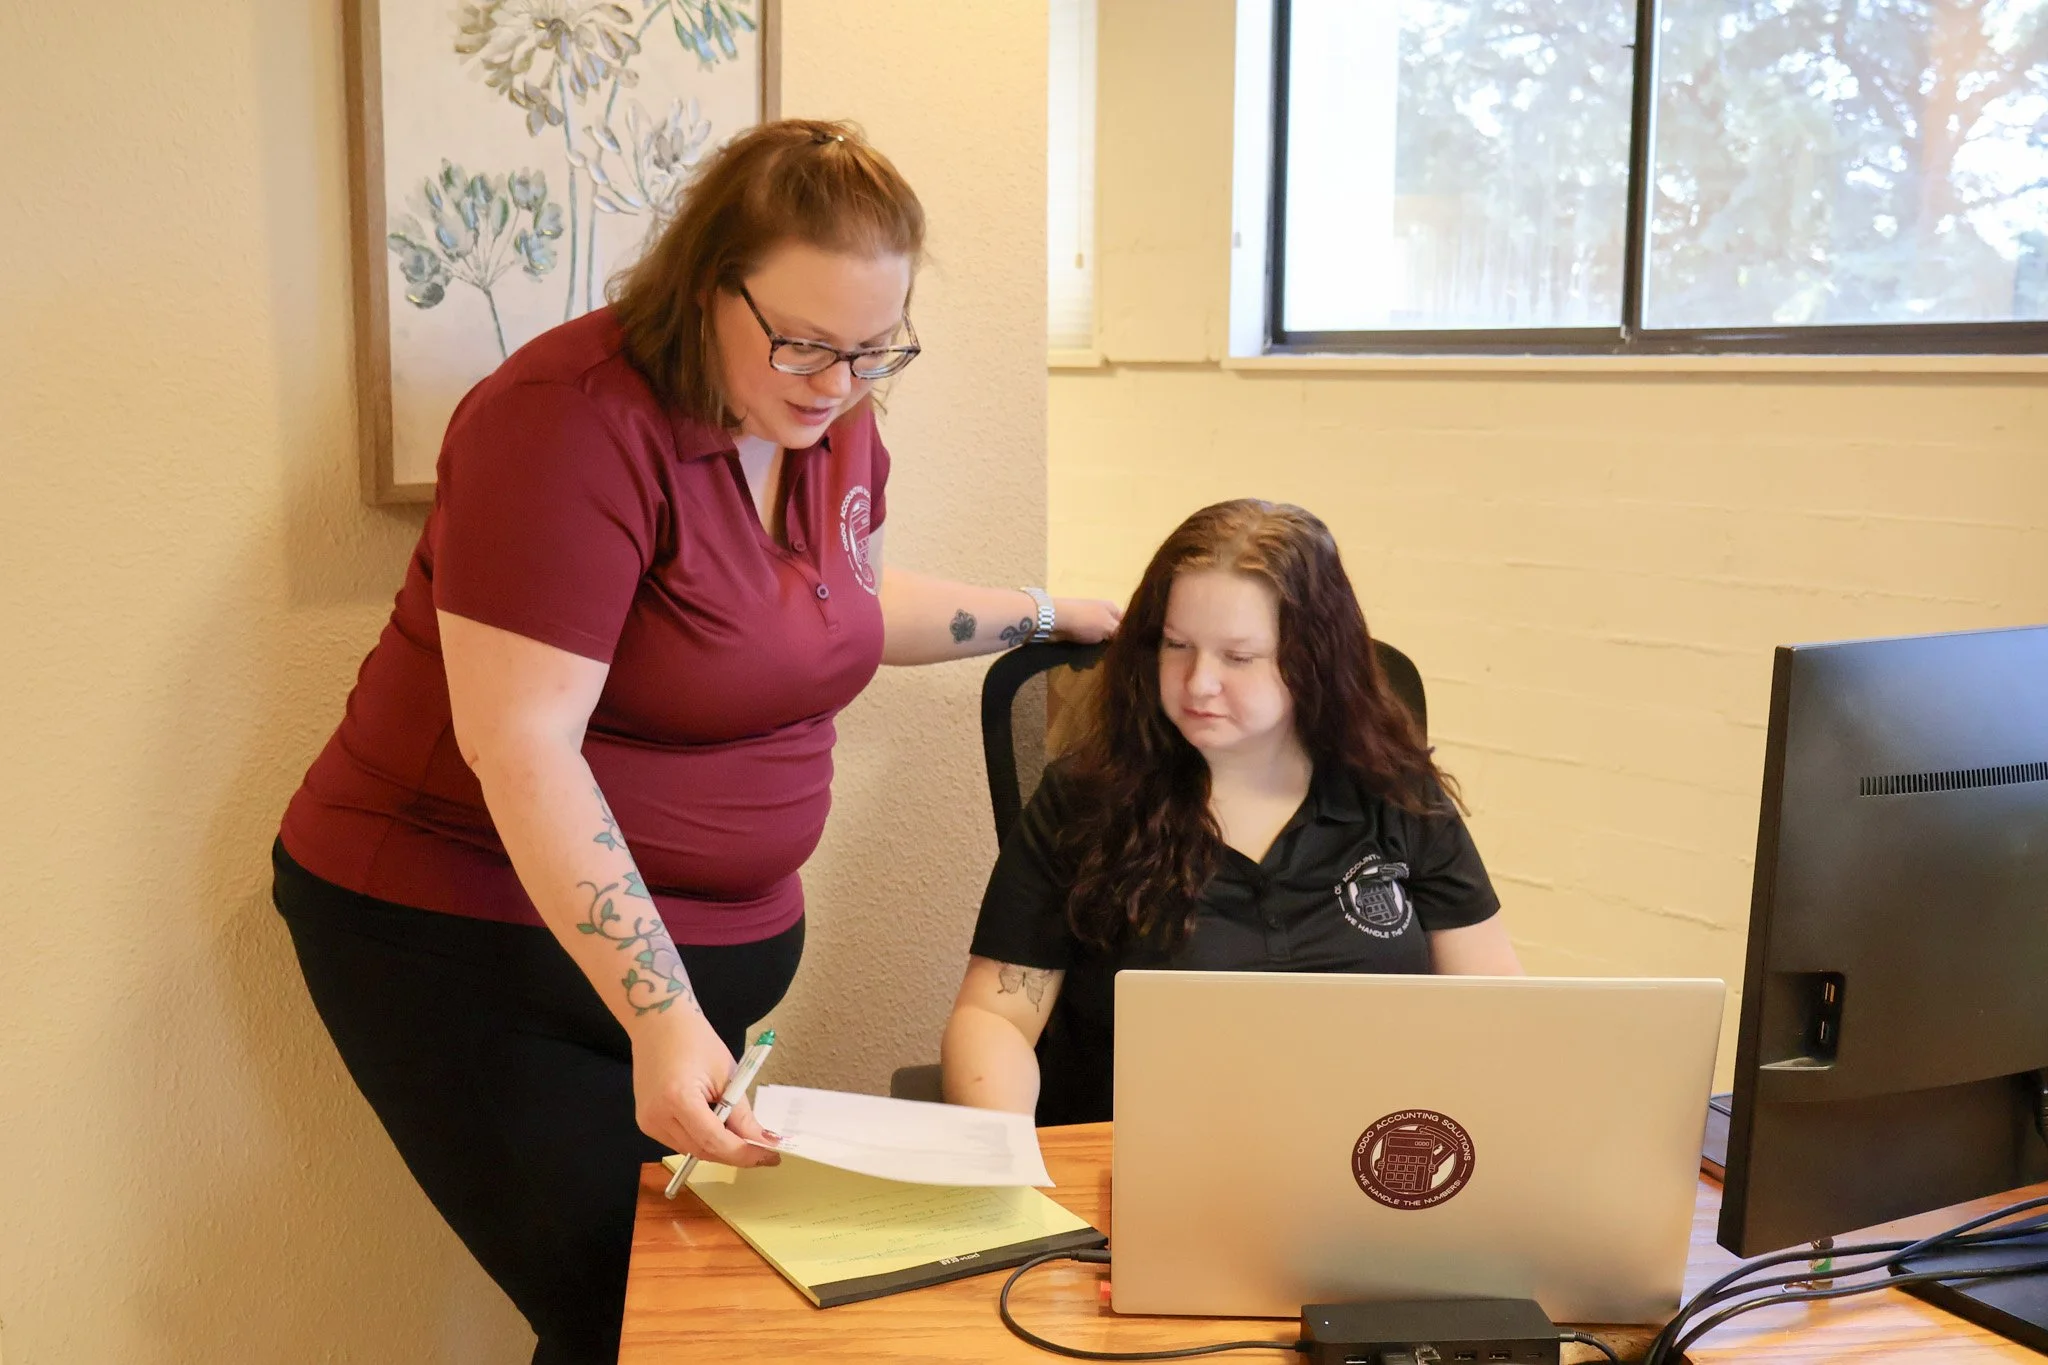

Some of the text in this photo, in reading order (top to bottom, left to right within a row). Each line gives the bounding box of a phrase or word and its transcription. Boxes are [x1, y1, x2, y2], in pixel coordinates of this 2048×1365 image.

[1358, 924, 1390, 939] HANDLE
[1357, 1112, 1471, 1161] ODDO ACCOUNTING SOLUTIONS
[1359, 1173, 1370, 1187] WE
[1368, 1186, 1400, 1205] HANDLE
[1424, 1180, 1461, 1205] NUMBERS!
